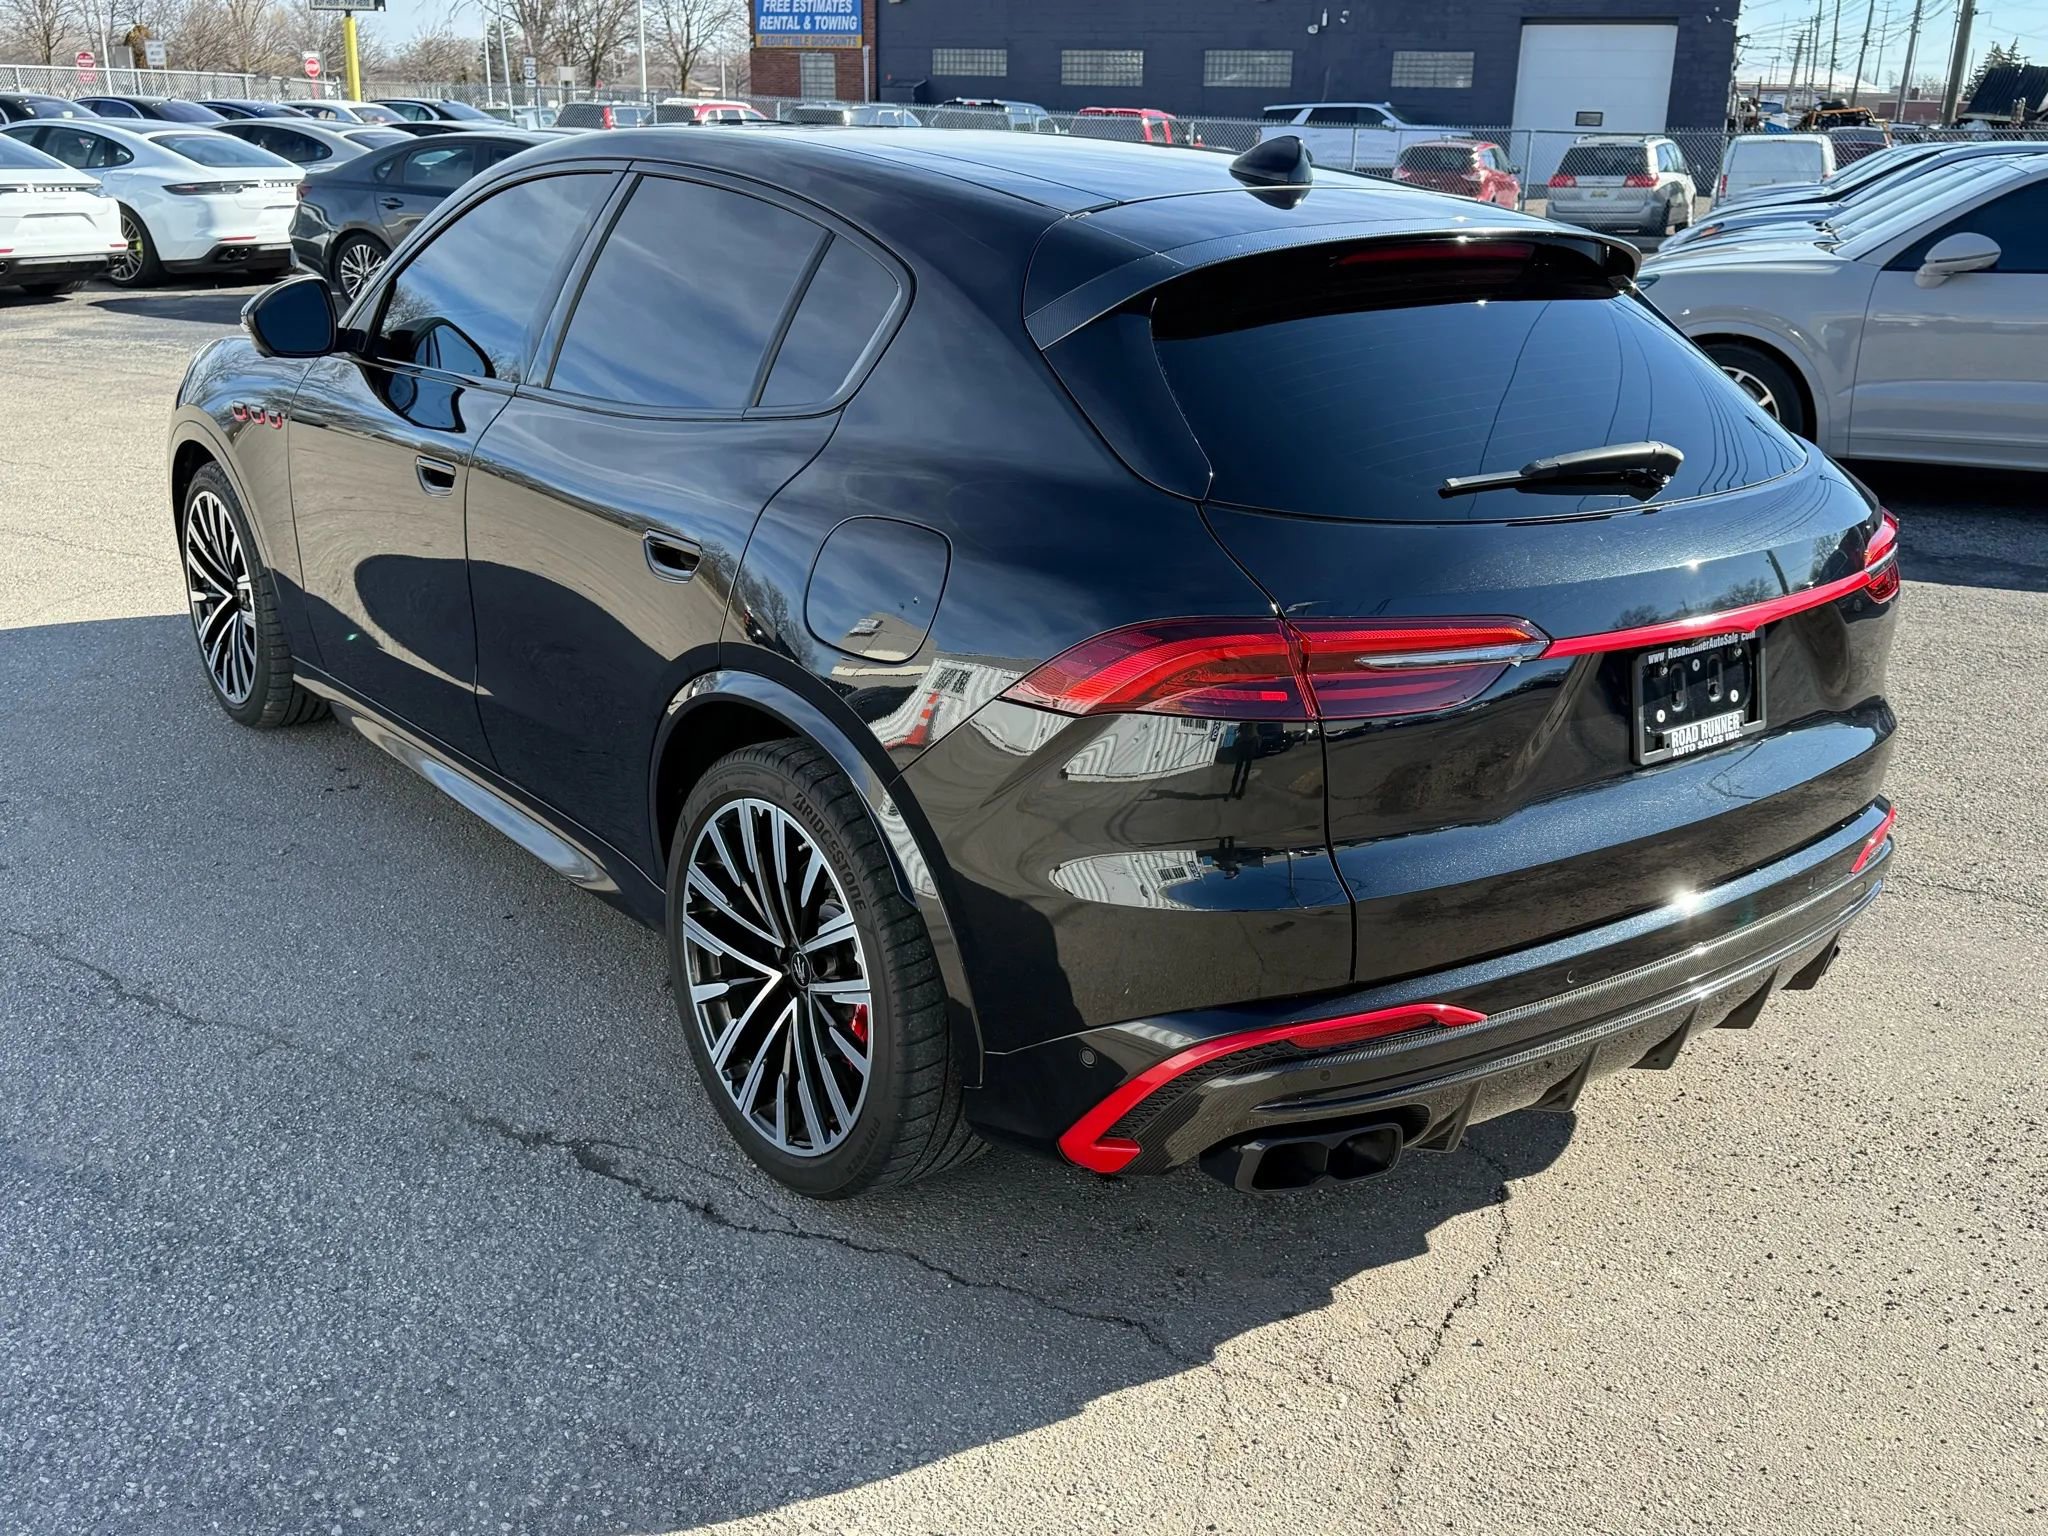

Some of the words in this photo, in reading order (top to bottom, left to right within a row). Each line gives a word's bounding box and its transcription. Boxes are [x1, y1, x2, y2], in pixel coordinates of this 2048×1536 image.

[763, 0, 790, 13] FREE
[792, 0, 852, 13] ESTIMATES
[759, 16, 800, 30] RENTAL
[803, 15, 812, 30] &
[814, 16, 858, 30] TOWING
[1671, 726, 1698, 749] ROAD
[1701, 713, 1740, 740] RUNNER
[1673, 743, 1696, 757] AUTO
[1697, 734, 1724, 749] SALES
[791, 792, 866, 912] BRIDGESTONE
